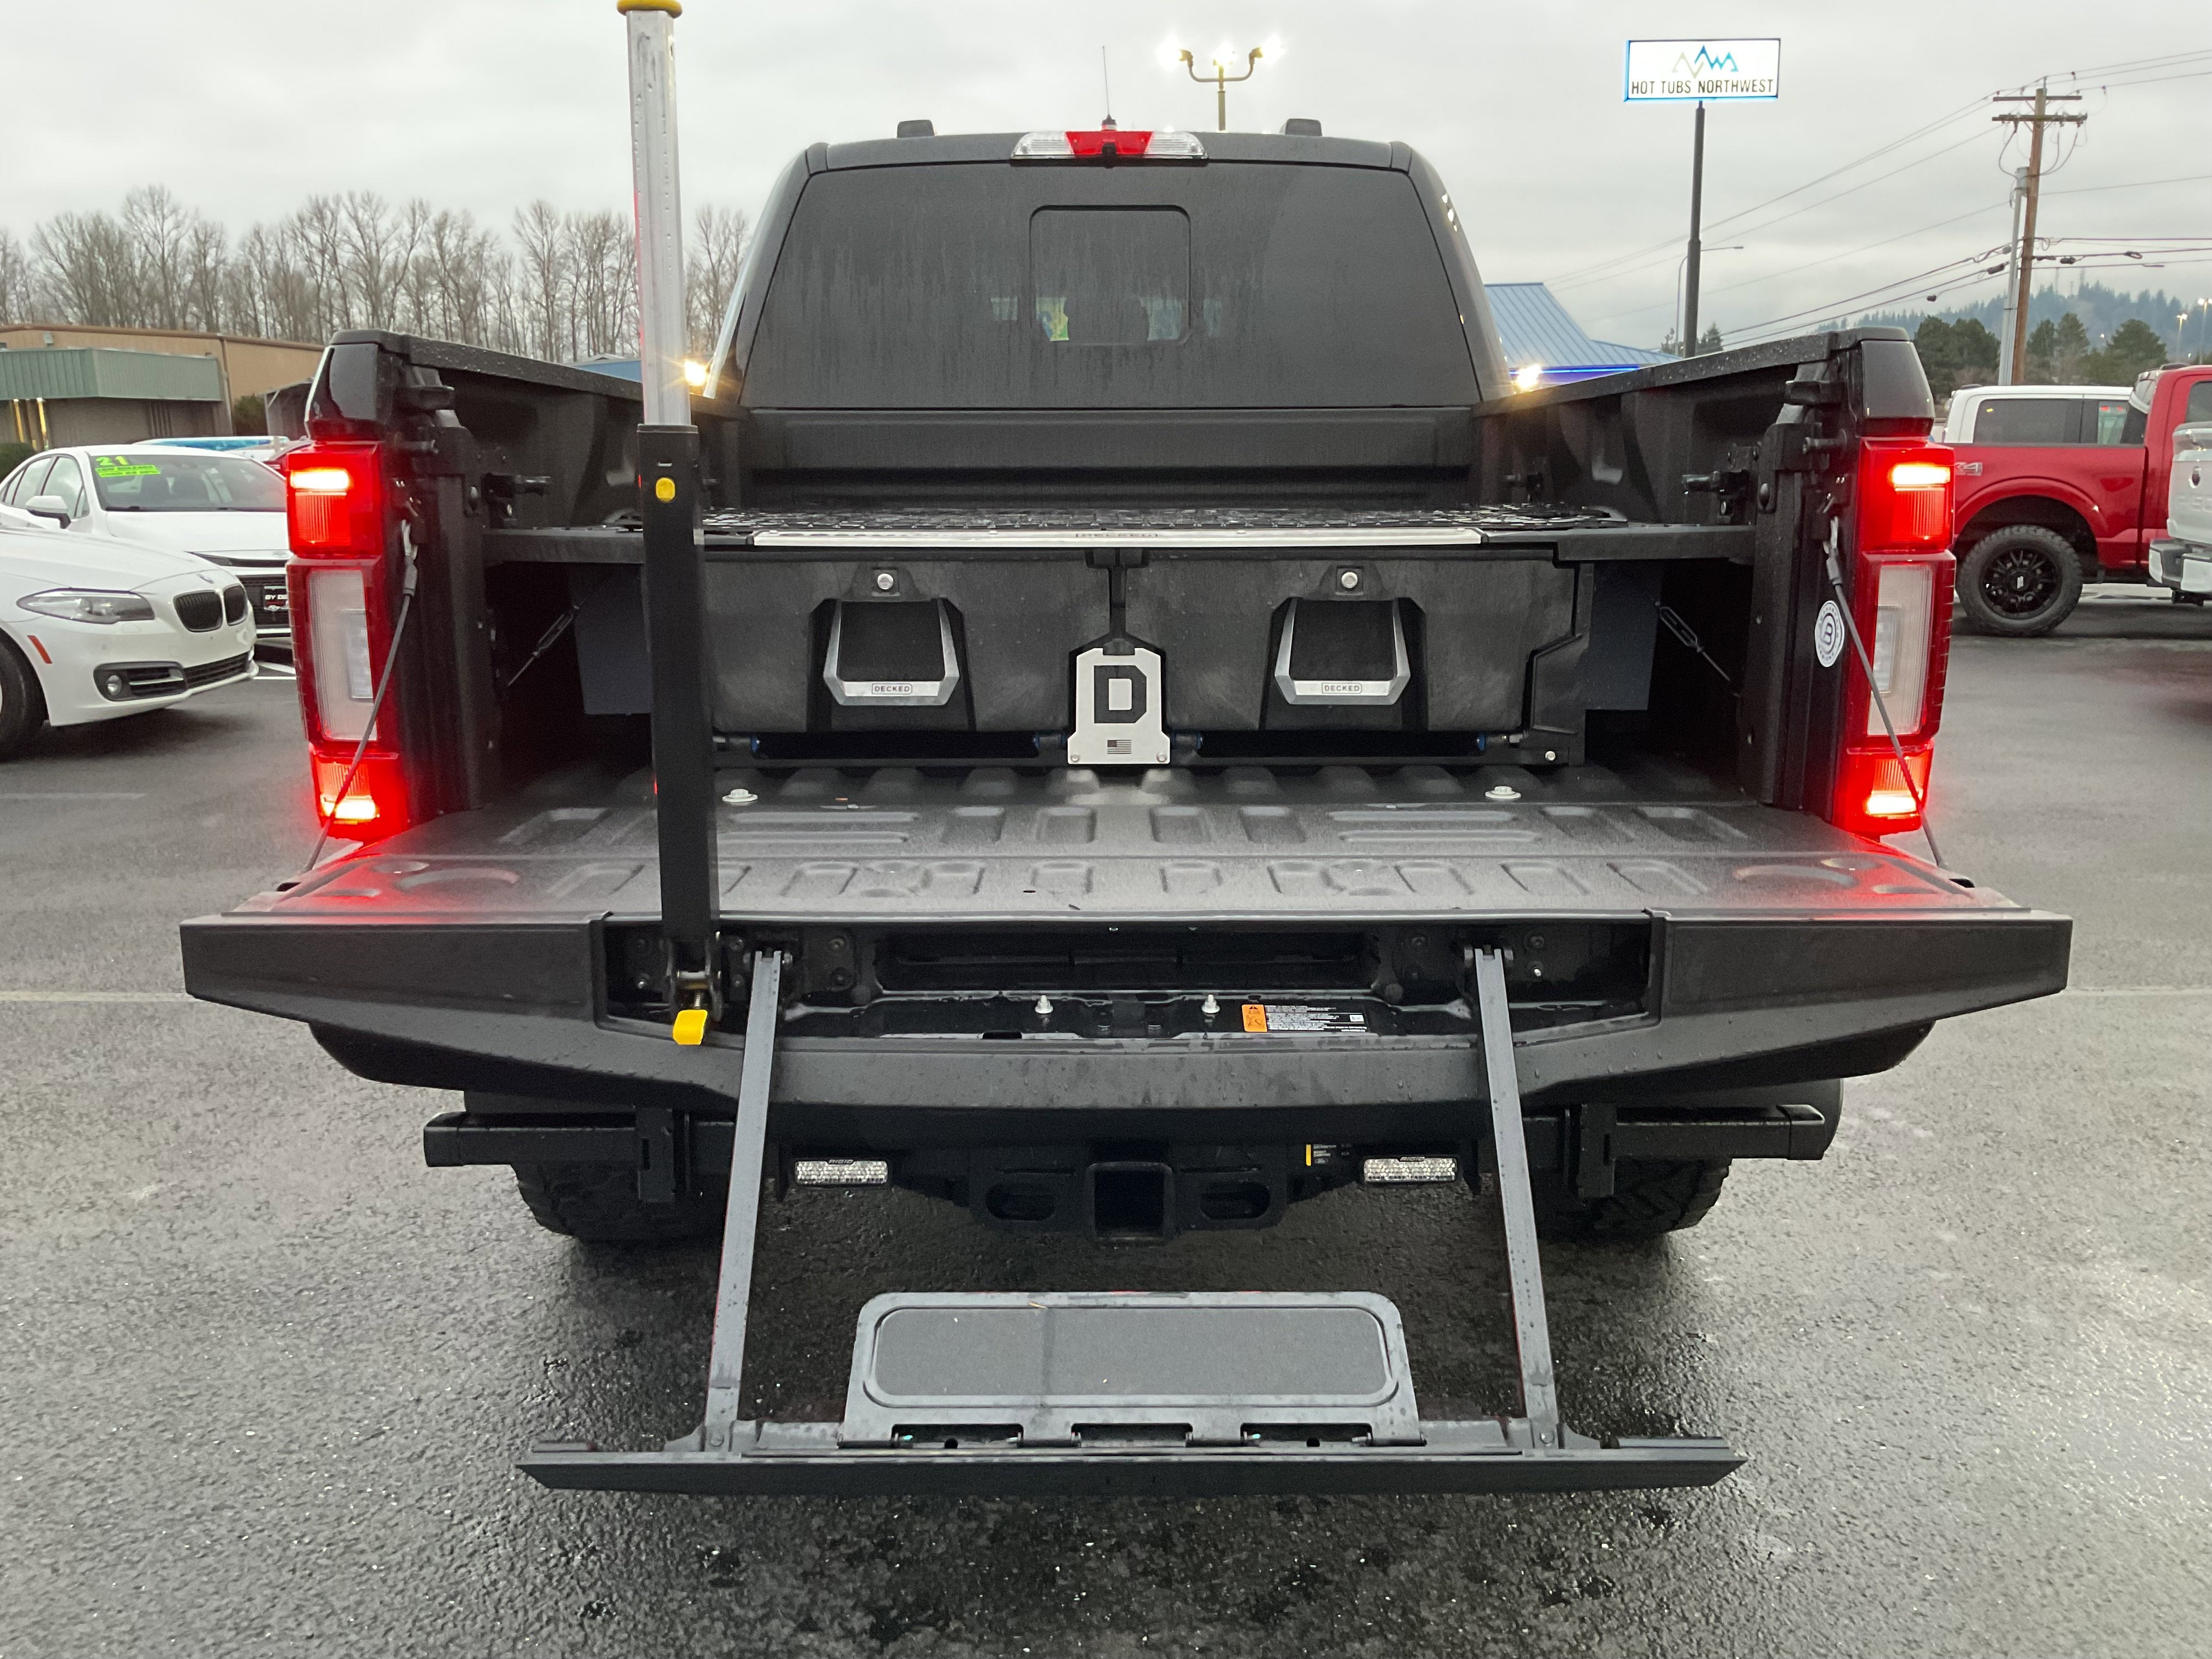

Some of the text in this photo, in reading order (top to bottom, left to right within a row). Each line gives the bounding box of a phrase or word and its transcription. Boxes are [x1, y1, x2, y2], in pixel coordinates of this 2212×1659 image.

[1632, 79, 1774, 94] HOT TUBS NORTHWEST
[95, 456, 129, 466] 21
[1094, 665, 1147, 723] D
